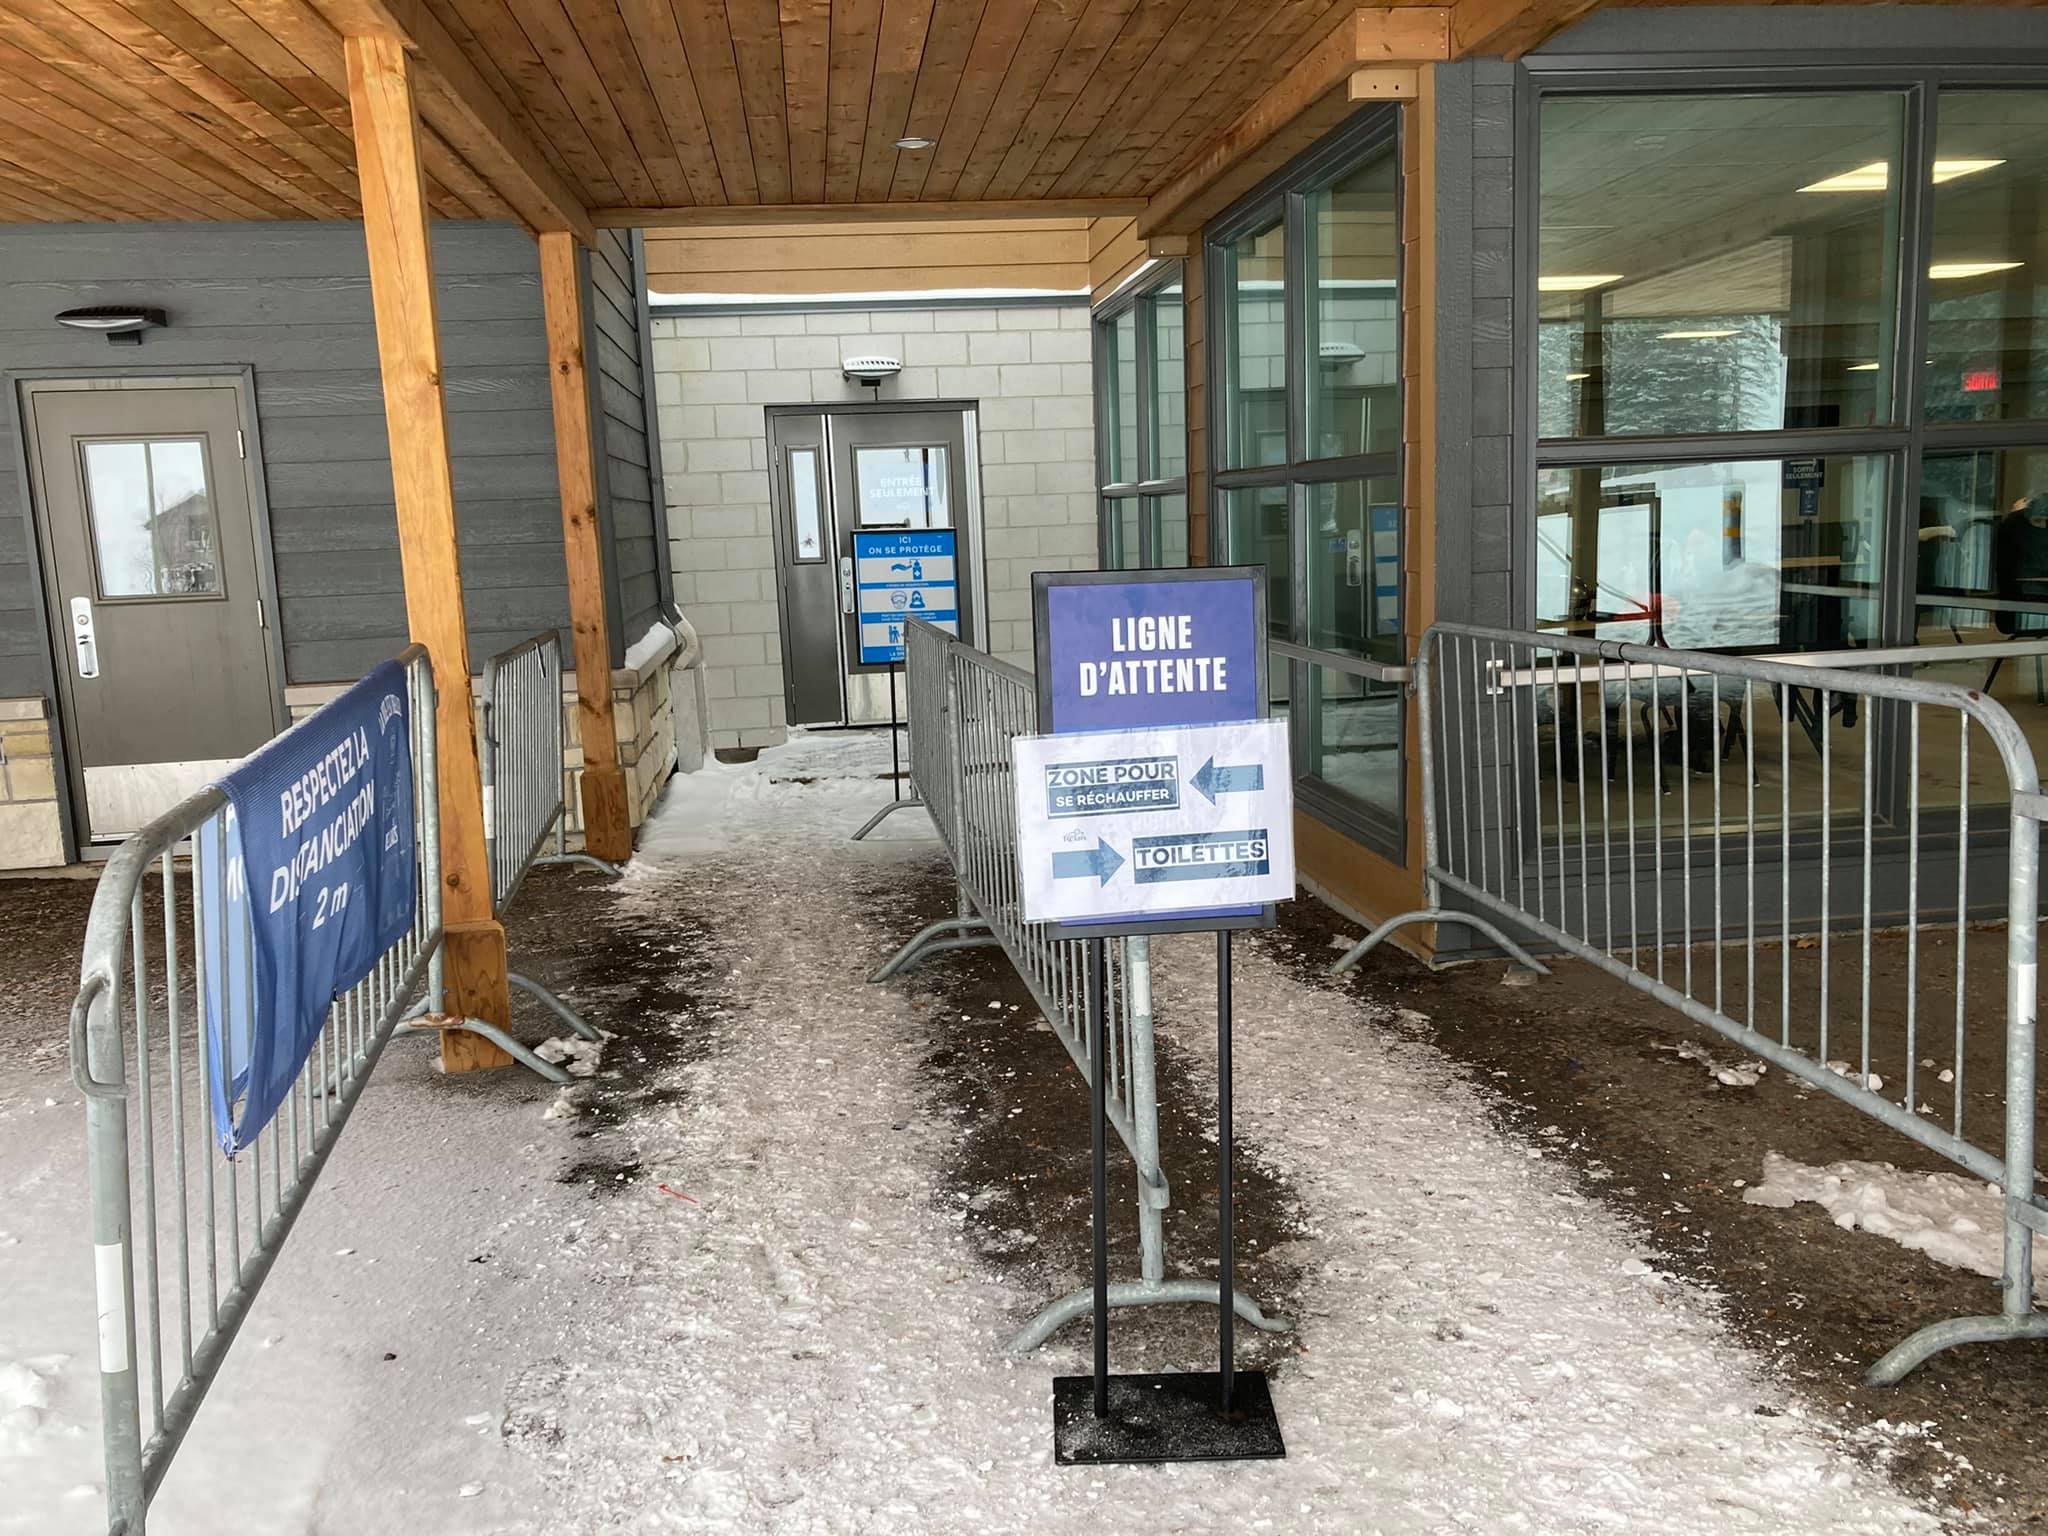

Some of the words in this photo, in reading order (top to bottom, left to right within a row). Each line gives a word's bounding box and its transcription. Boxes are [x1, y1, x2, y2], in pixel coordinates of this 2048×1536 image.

[869, 487, 935, 498] SEULEMENT
[868, 547, 882, 555] ON
[885, 546, 897, 554] SE
[898, 536, 912, 544] ICI
[1112, 615, 1192, 652] LIGNE
[1079, 657, 1228, 697] D'ATTENTE
[281, 737, 356, 839] RESPECTEZ
[352, 725, 370, 769] LA
[1047, 765, 1109, 789] ZONE
[1115, 763, 1175, 783] POUR
[1056, 795, 1074, 808] SE
[1077, 787, 1170, 806] RÉCHAUFFER
[1136, 840, 1265, 867] TOILETTES
[312, 886, 329, 931] 2
[330, 881, 348, 918] m
